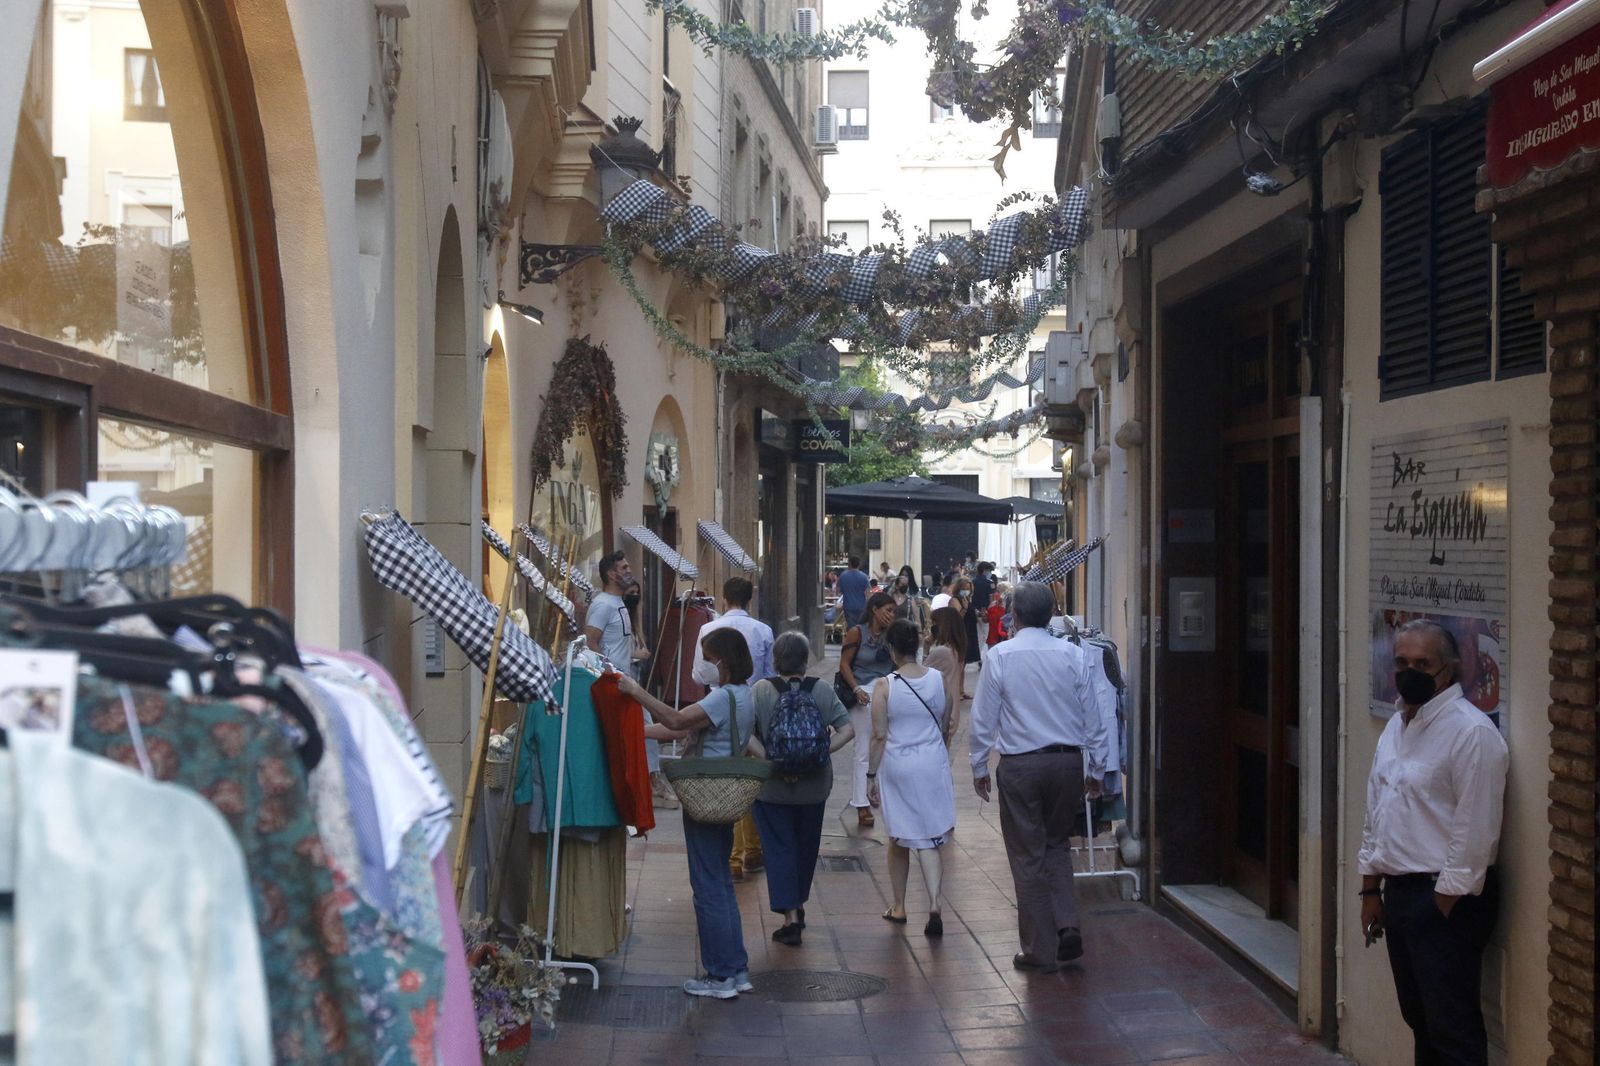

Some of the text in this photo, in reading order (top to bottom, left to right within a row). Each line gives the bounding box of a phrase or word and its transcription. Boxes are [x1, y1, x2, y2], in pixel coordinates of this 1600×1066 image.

[1392, 451, 1426, 489] BAR
[1381, 575, 1400, 603] Plaza
[1400, 578, 1408, 596] de
[1410, 576, 1424, 599] San
